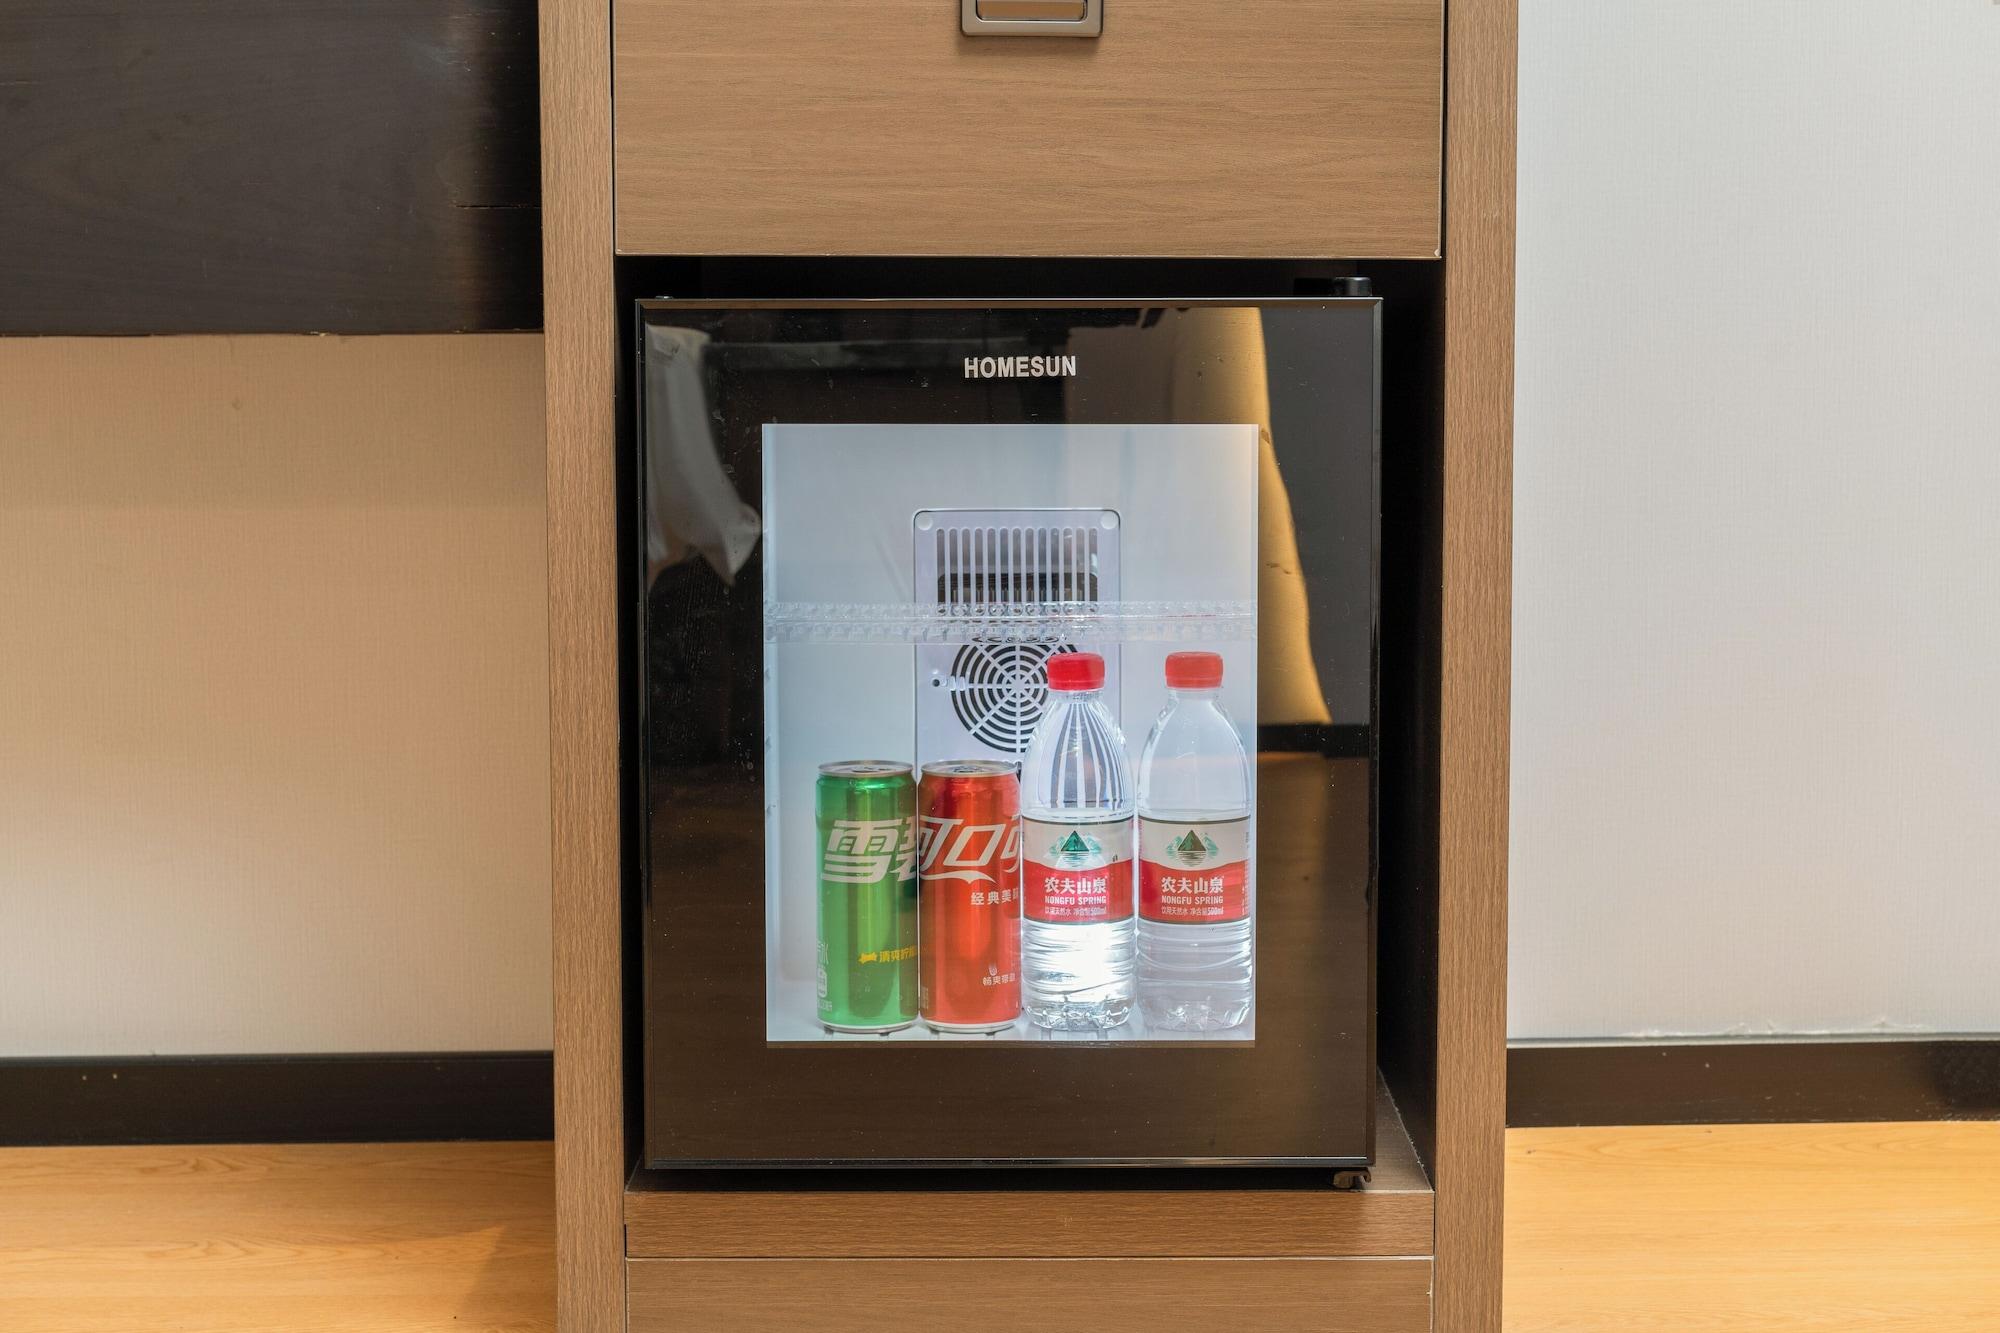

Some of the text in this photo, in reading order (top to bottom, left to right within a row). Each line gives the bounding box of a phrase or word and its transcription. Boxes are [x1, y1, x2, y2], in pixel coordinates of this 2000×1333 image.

[964, 356, 1077, 378] HOMESUN
[1044, 877, 1107, 895] 农夫山泉
[1161, 877, 1224, 895] 农夫山泉
[1044, 895, 1107, 906] NONGFU SPRING
[1161, 895, 1224, 906] NONGFU SPRING
